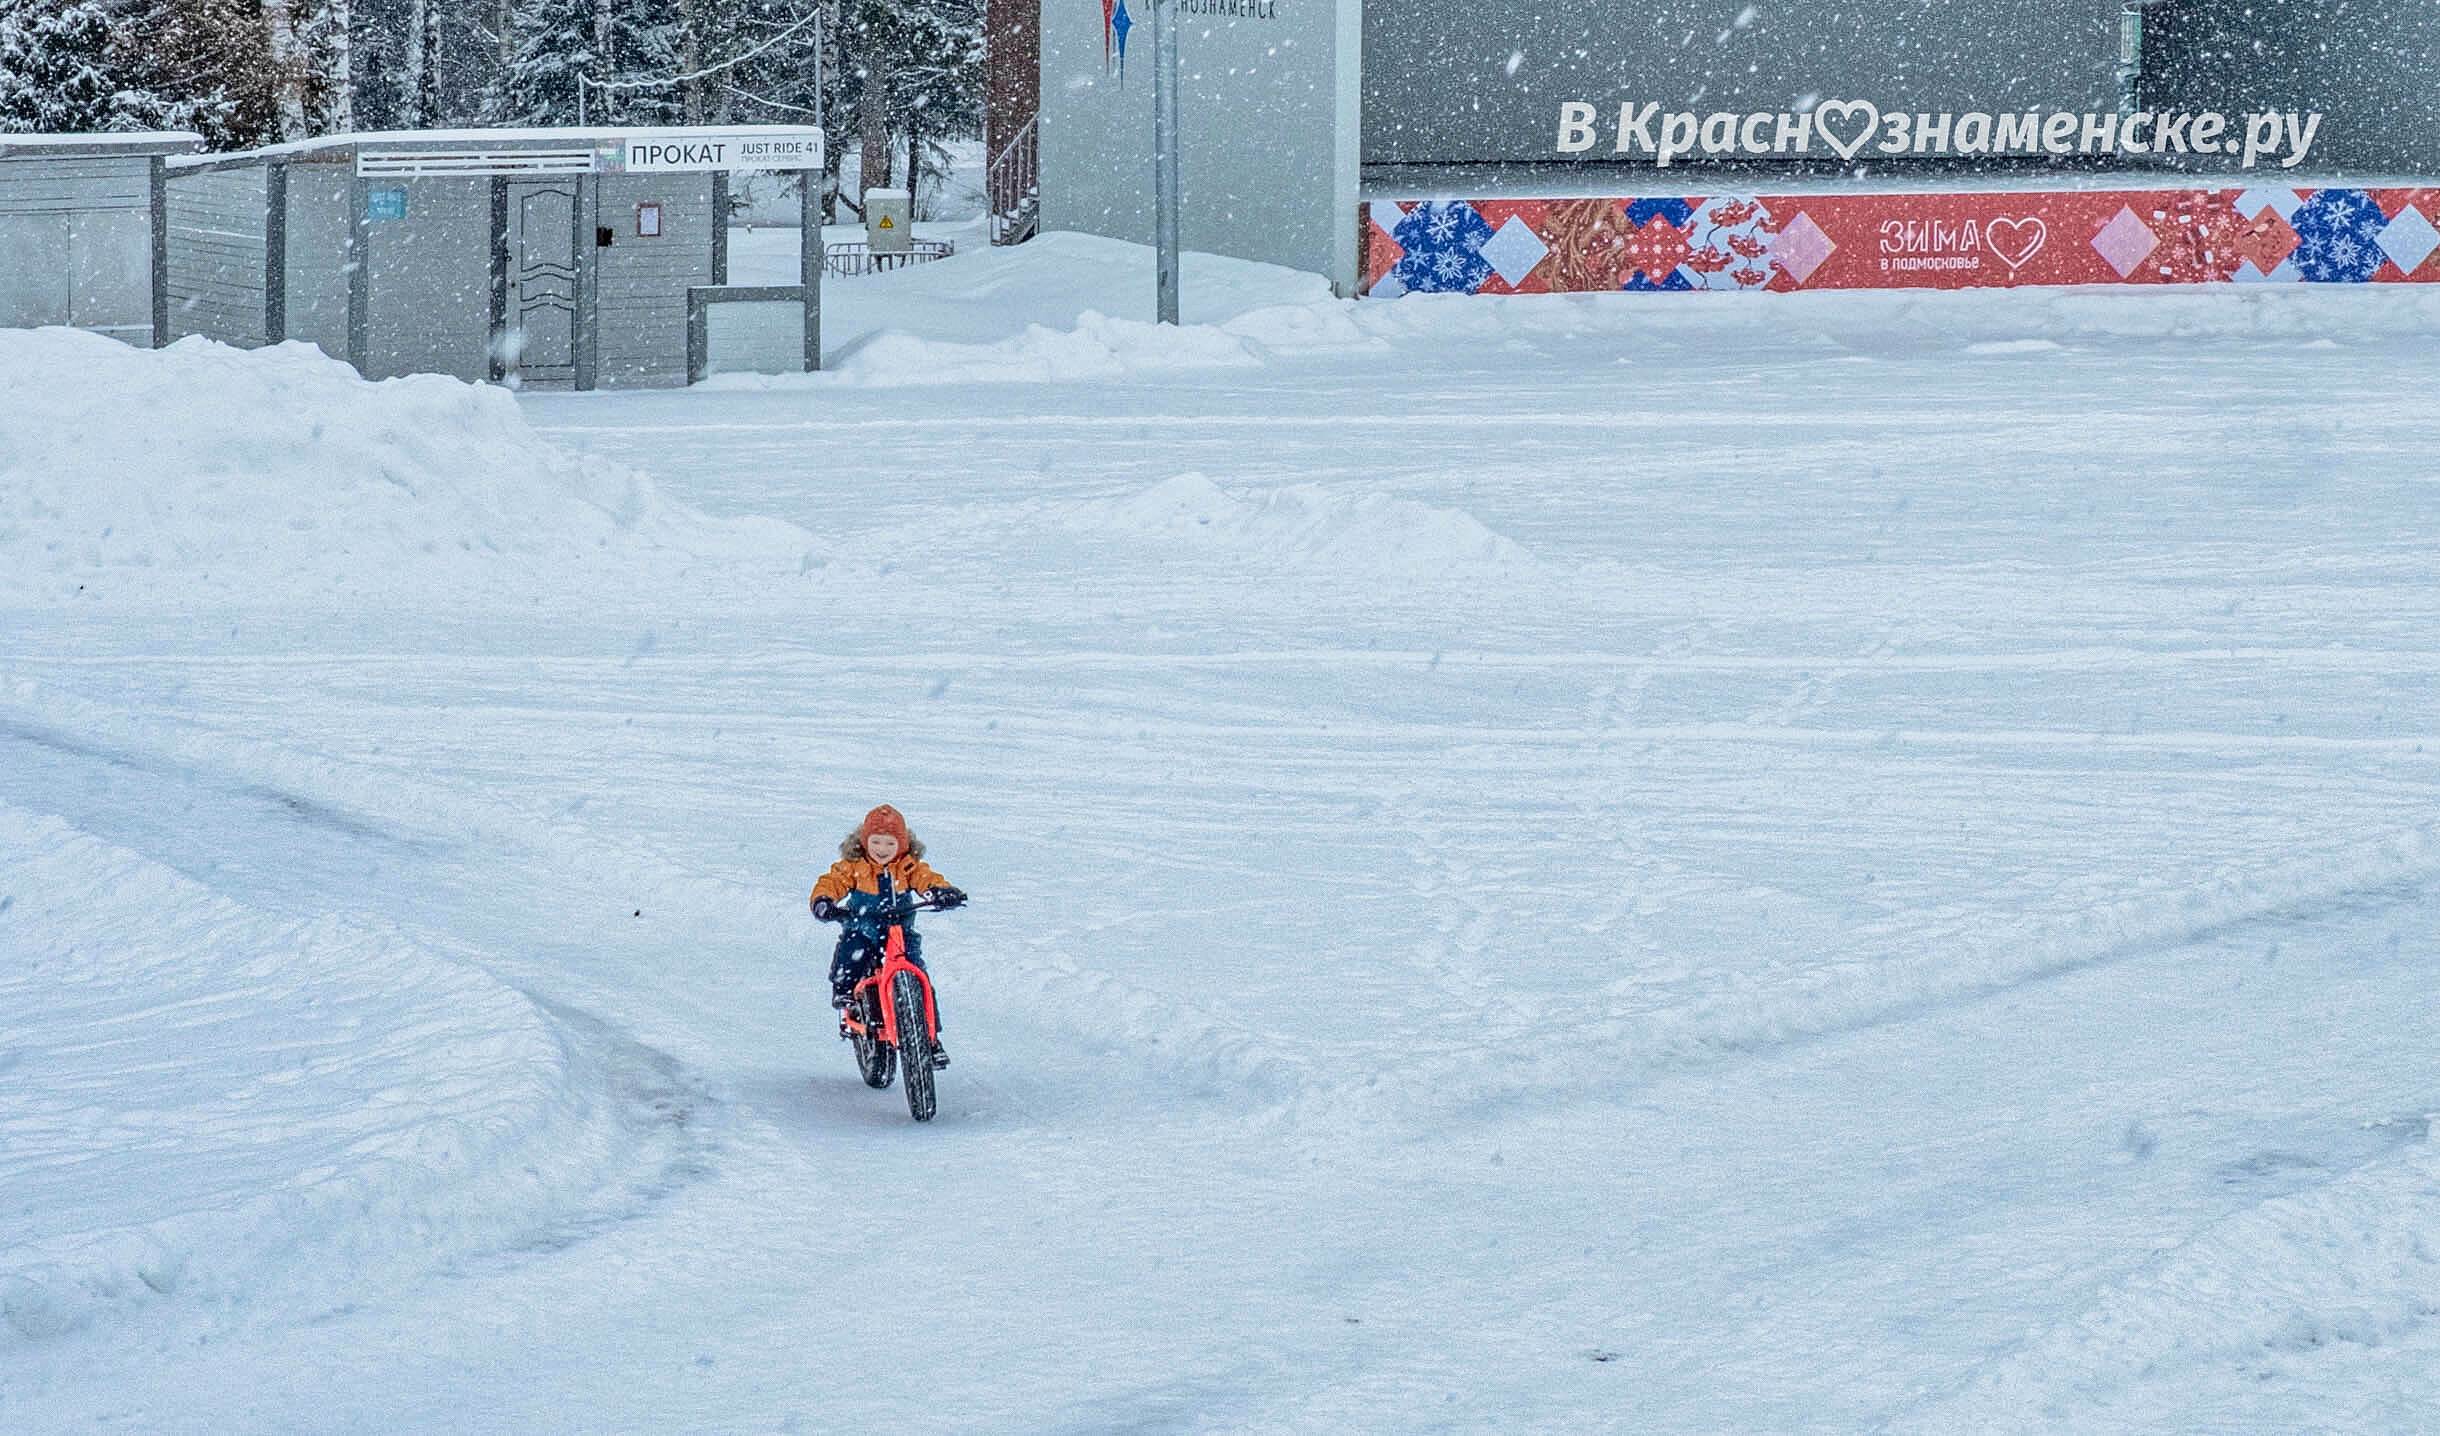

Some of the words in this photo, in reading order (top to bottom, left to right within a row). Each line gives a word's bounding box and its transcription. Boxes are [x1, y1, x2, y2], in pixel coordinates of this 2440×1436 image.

[632, 144, 726, 165] ПРОКАТ
[741, 143, 769, 154] JUST
[773, 142, 802, 153] RIDE
[806, 142, 818, 152] 41
